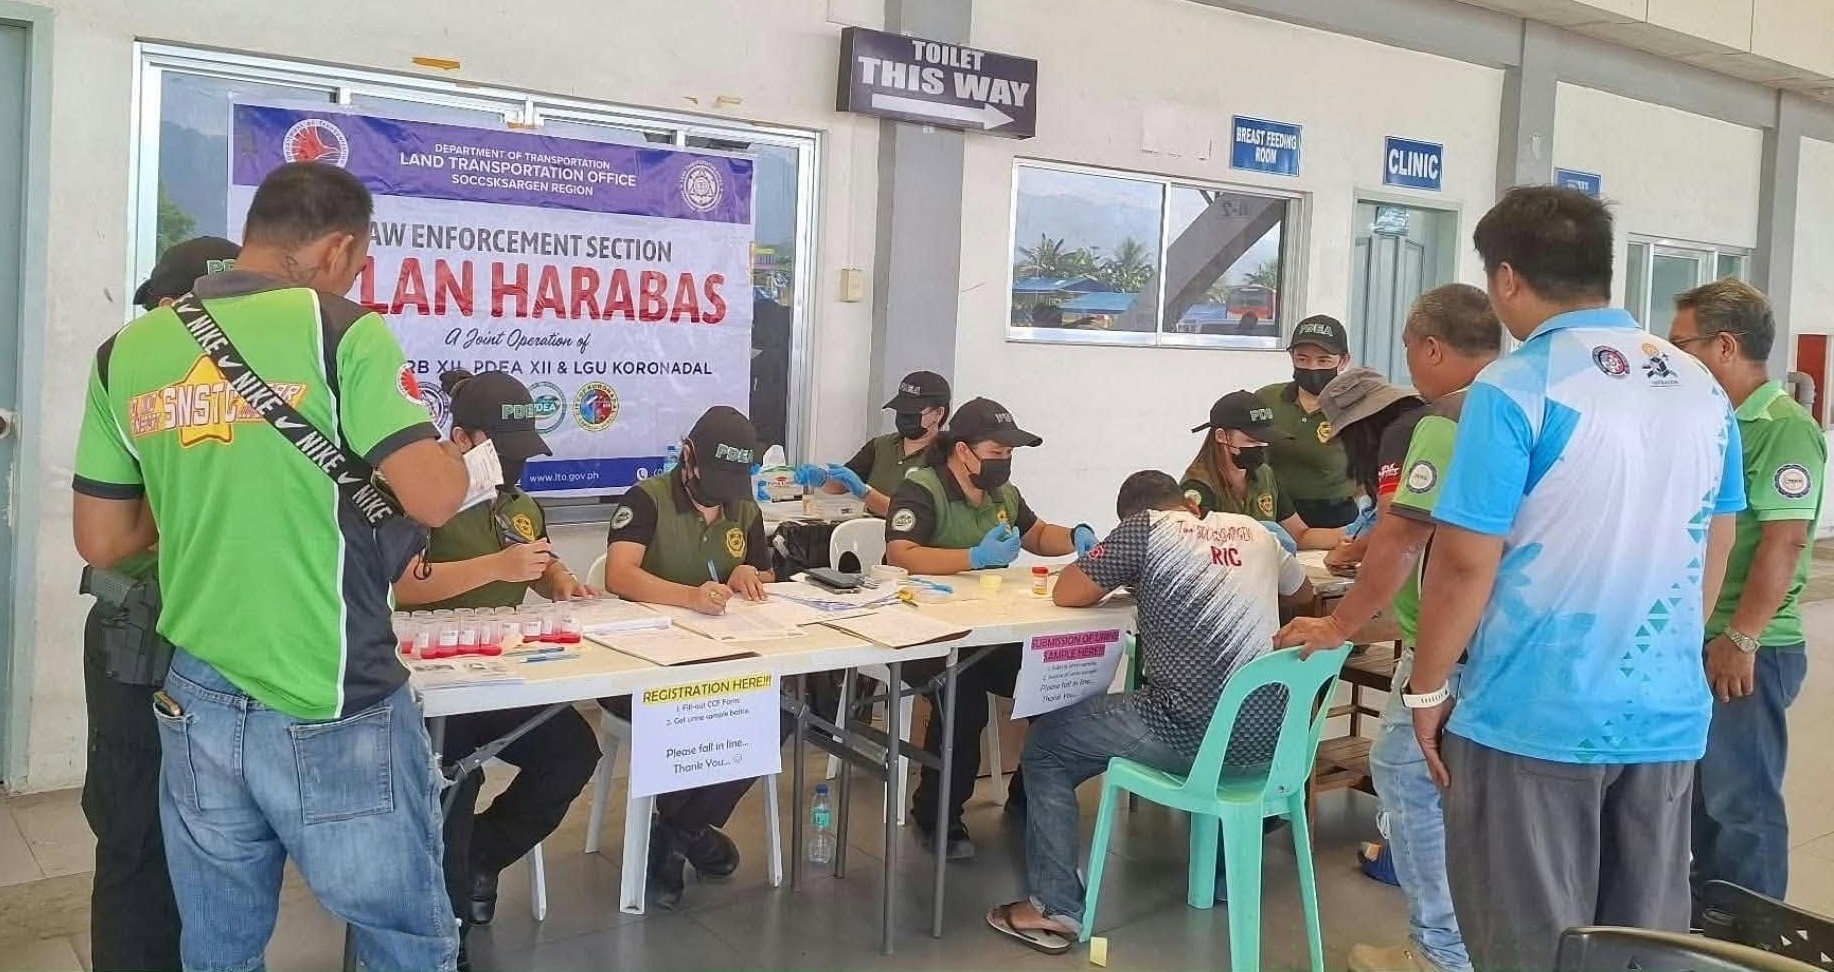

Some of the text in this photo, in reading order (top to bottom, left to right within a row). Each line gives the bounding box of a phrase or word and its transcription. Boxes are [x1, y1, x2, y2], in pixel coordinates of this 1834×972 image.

[912, 40, 985, 71] TOILET
[857, 56, 1031, 107] THIS WAY
[1236, 126, 1297, 150] BREAST FEEDING
[435, 143, 610, 170] DEPARTMENT OF TRANSPORTATION
[1255, 146, 1277, 164] ROOM
[1388, 148, 1439, 181] CLINIC
[400, 152, 637, 187] LAND TRANSPORTATION OFFICE
[452, 174, 593, 196] SOCCSKSARGEN REGION
[369, 221, 672, 262] AW ENFORCEMENT SECTION
[359, 255, 727, 325] LAN HARABAS
[445, 327, 591, 354] A Joint Operation of
[406, 360, 429, 374] RB
[474, 360, 523, 374] PDEA
[530, 360, 551, 374] XII
[557, 361, 567, 374] &
[574, 361, 606, 375] LGU
[613, 361, 712, 375] KORONADAL
[186, 314, 393, 524] NIKE NIKE NIKE NIKE
[1210, 545, 1242, 567] RIC
[642, 675, 772, 703] REGISTRATION HERE!!!
[666, 745, 697, 759] Please
[698, 742, 713, 754] fall
[715, 742, 725, 751] in
[673, 761, 703, 774] Thank
